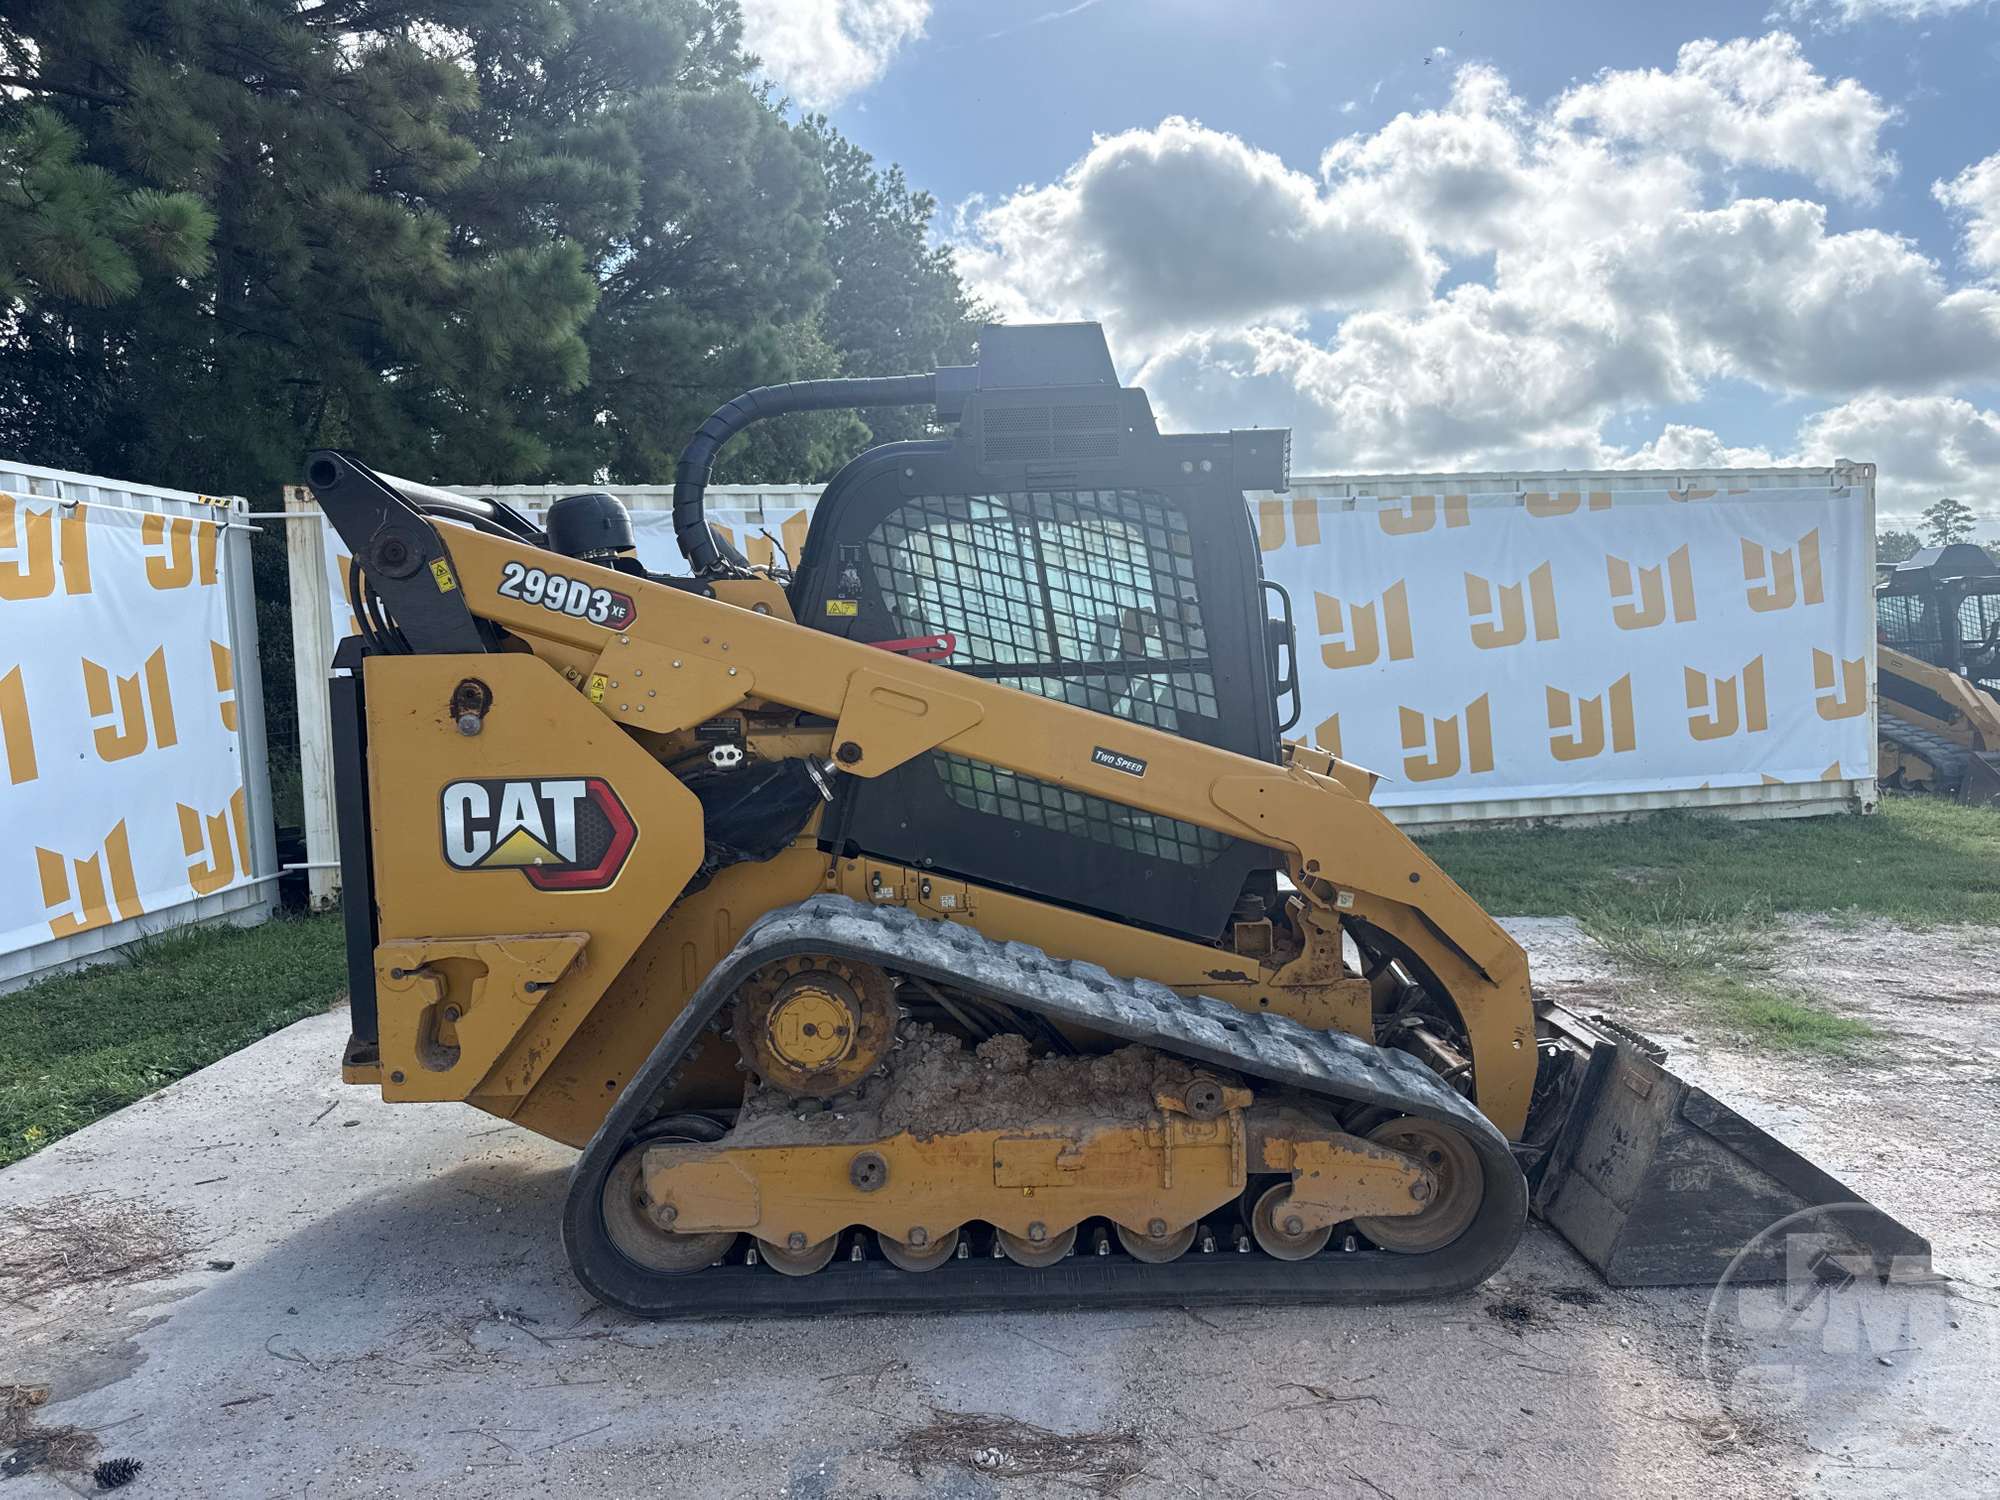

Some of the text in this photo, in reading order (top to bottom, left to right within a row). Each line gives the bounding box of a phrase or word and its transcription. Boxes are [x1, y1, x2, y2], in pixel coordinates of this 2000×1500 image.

[499, 562, 627, 624] 299D3 XE
[443, 779, 587, 868] CAT
